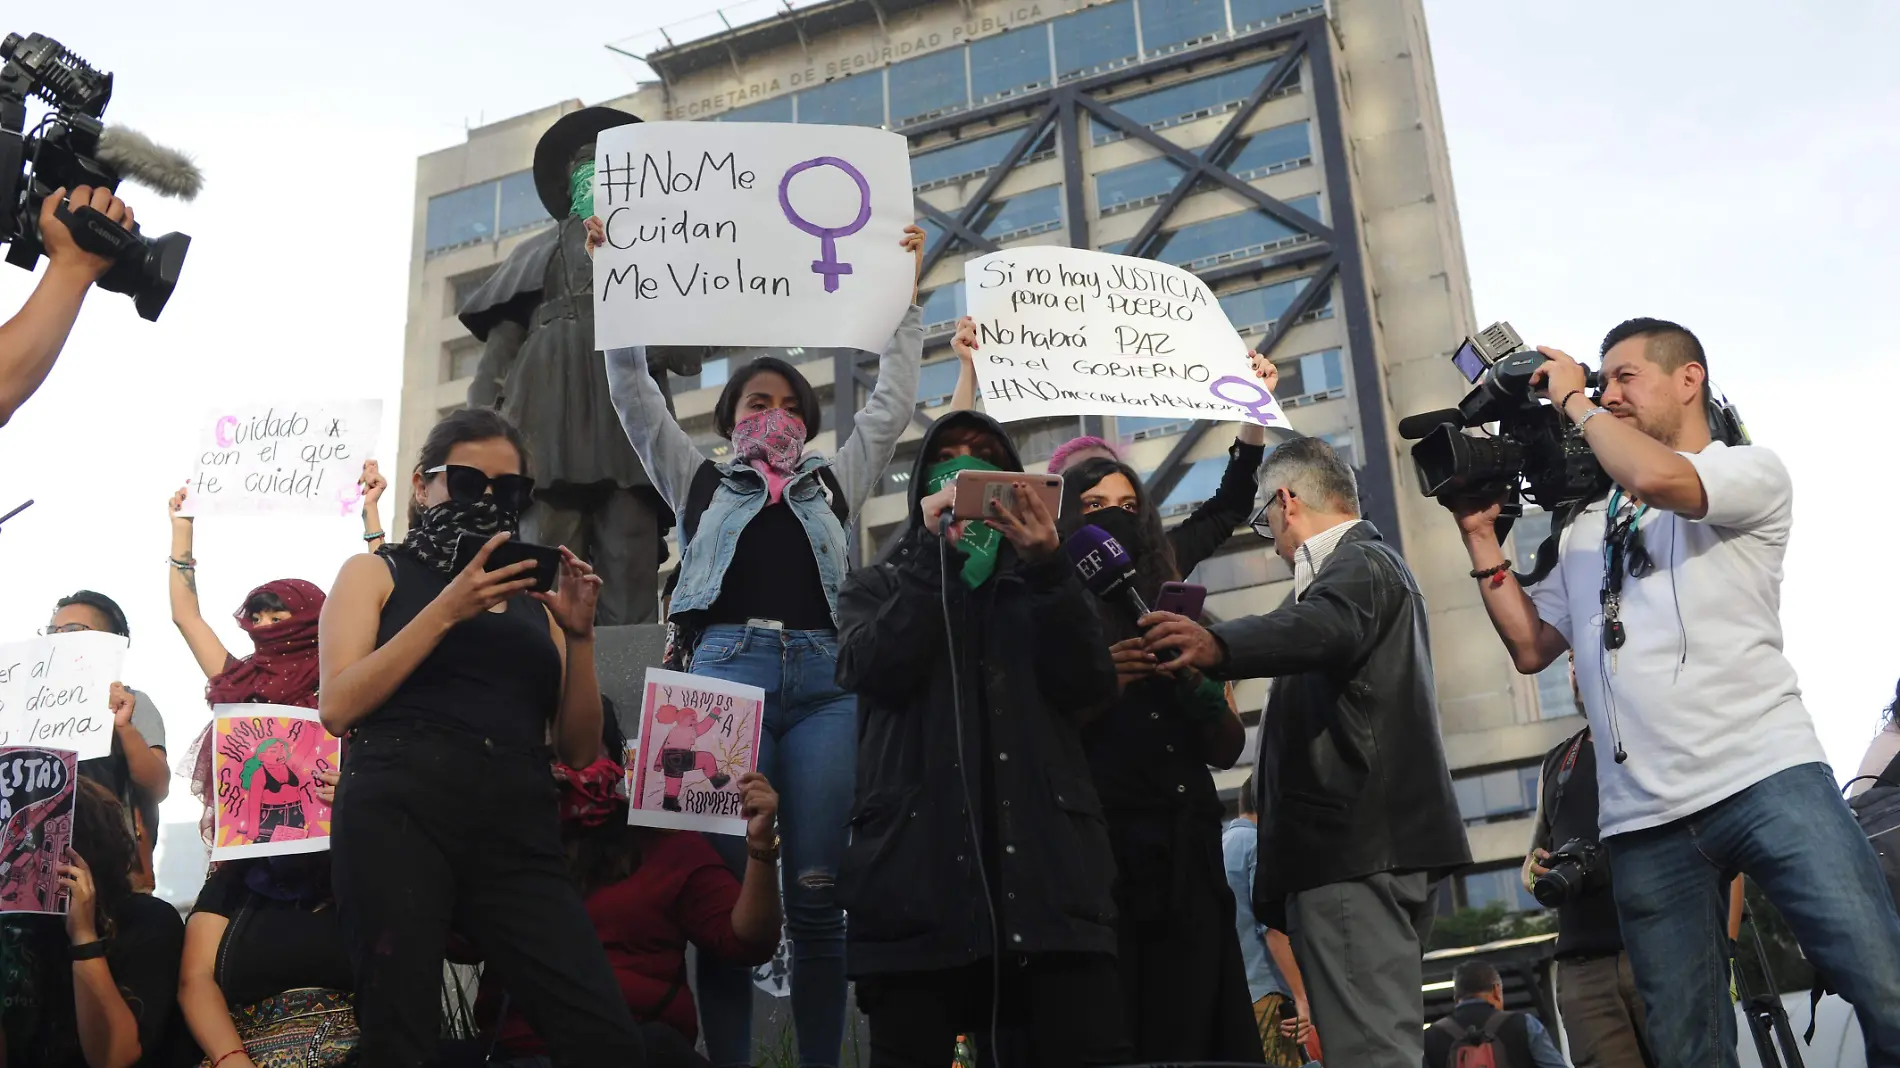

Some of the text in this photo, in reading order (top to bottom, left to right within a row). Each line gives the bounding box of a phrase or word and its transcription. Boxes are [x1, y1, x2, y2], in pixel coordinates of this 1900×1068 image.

[790, 67, 816, 87] DE
[826, 32, 942, 76] SEGURIDAD
[952, 4, 1043, 40] PUBLICA
[605, 206, 737, 250] Cuidan
[602, 258, 790, 302] Me Violan
[979, 259, 1207, 307] Si no hay JUSTICIA
[1011, 289, 1059, 314] para
[1064, 293, 1086, 313] el
[980, 318, 1176, 357] No habrá PAZ
[1072, 358, 1211, 383] GOBIERNO
[214, 407, 310, 449] Cuidado
[200, 441, 351, 472] con el que
[190, 466, 325, 499] te cuida!
[30, 645, 56, 679] al
[25, 684, 89, 712] dicen
[662, 685, 734, 713] Y VAMOS
[27, 716, 104, 744] lema
[218, 717, 304, 764] VAMOS A
[720, 712, 735, 738] A
[684, 788, 741, 817] ROMPER
